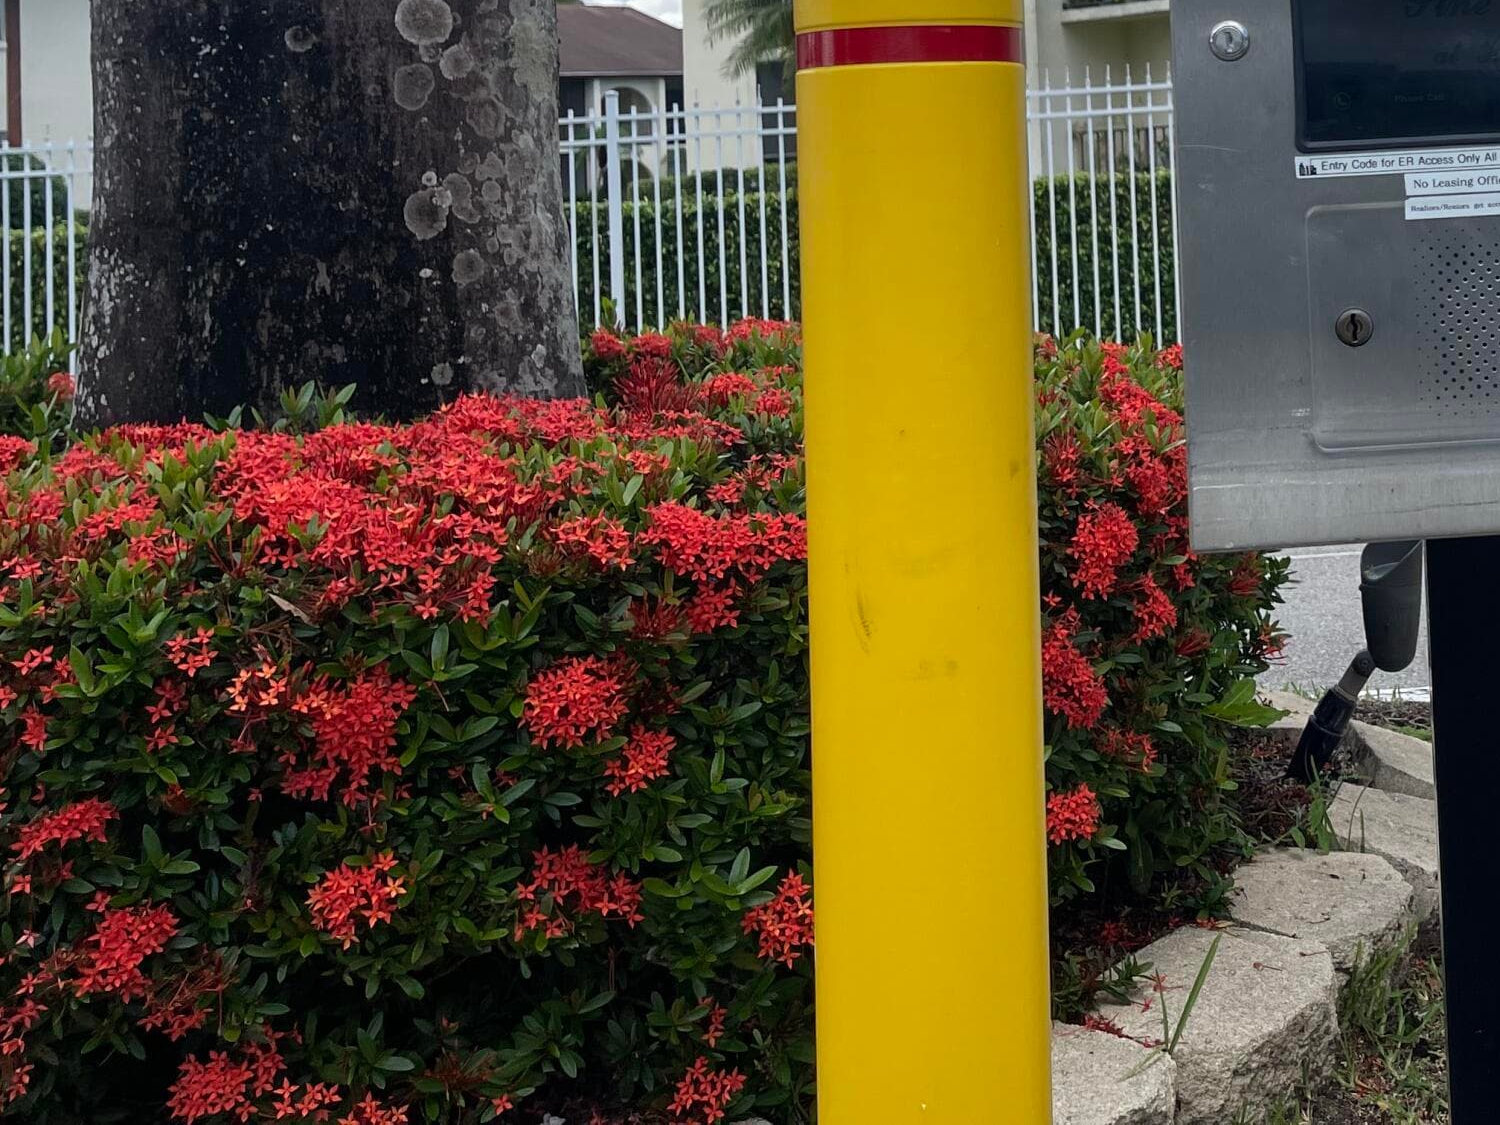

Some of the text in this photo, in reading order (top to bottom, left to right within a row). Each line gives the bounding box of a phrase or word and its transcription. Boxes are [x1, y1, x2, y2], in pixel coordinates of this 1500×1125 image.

[1321, 160, 1348, 173] Entry
[1351, 159, 1378, 169] Code
[1381, 157, 1395, 168] for
[1398, 157, 1414, 167] ER
[1418, 155, 1454, 165] Access
[1457, 153, 1480, 166] Only
[1485, 152, 1497, 162] All
[1413, 178, 1429, 189] No
[1432, 176, 1473, 188] Leasing
